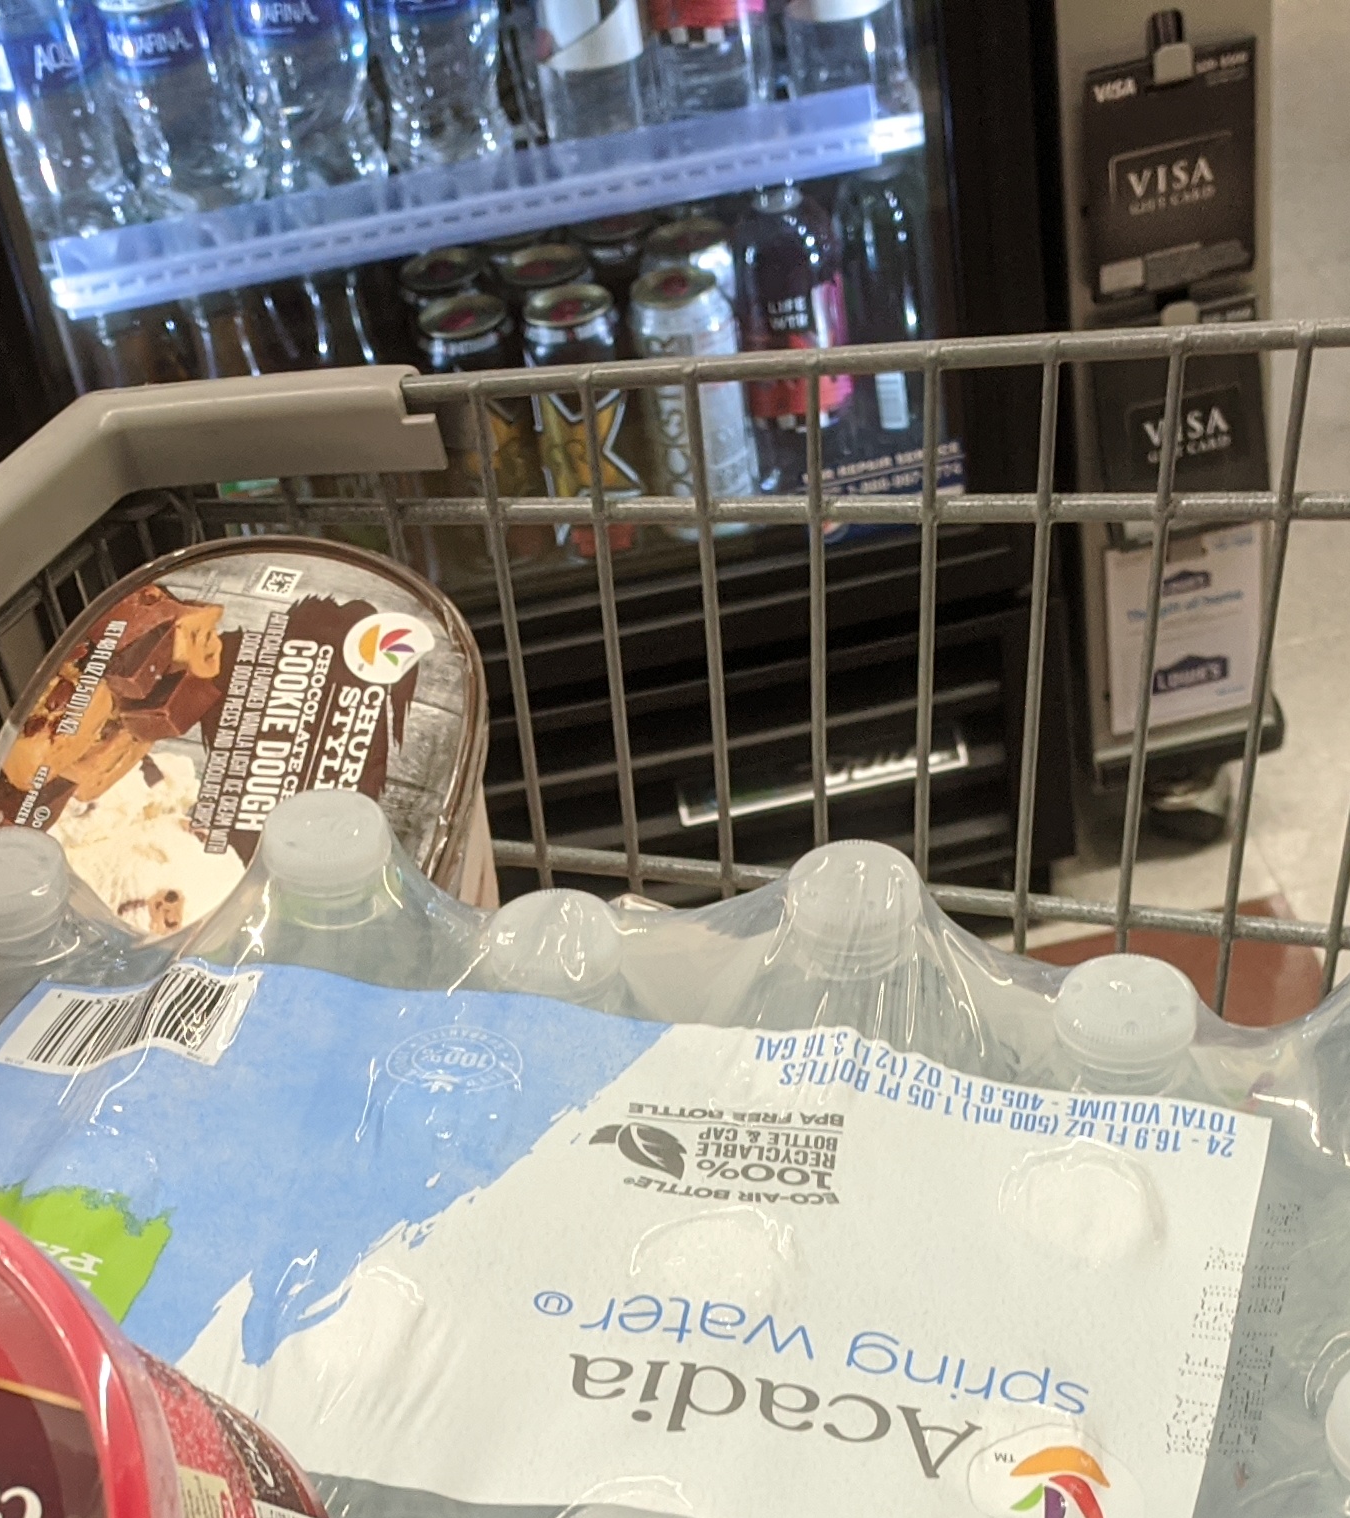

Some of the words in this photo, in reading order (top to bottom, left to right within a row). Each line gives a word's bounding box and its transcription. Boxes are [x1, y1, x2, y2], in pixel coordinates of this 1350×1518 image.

[1091, 75, 1138, 103] VISA
[1126, 155, 1215, 198] VISA
[235, 631, 259, 664] COOKIE
[257, 612, 287, 666] ARTIFICIALLY
[227, 664, 251, 696] DOUGH
[245, 665, 273, 710] FLAVORED
[260, 634, 317, 739] COOKIE
[218, 695, 242, 728] PIECES
[286, 643, 332, 773] CHOCOLATE
[212, 727, 234, 749] AND
[234, 709, 261, 748] VANILLA
[31, 763, 49, 789] KEEP
[199, 749, 228, 801] CHOCOLATE
[226, 749, 249, 777] LIGHT
[235, 737, 287, 835] DOUGH
[14, 787, 39, 826] FROZEN
[191, 801, 215, 830] CHIPS
[213, 794, 238, 827] CREAM
[205, 826, 229, 854] WITH
[751, 1031, 797, 1064] GAL
[874, 1046, 909, 1079] (12
[913, 1059, 942, 1087] OZ
[873, 1072, 902, 1099] PT
[904, 1083, 952, 1115] 1.05
[947, 1074, 973, 1099] FL
[979, 1083, 1044, 1112] 405.6
[628, 1102, 723, 1120] BOTTLE
[799, 1111, 844, 1127] BPA
[961, 1099, 1003, 1125] mL)
[1007, 1107, 1059, 1135] (500
[1065, 1091, 1161, 1127] VOLUME
[1166, 1104, 1238, 1136] TOTAL
[697, 1125, 738, 1142] CAP
[745, 1129, 760, 1144] &
[767, 1131, 838, 1149] BOTTLE
[1064, 1116, 1095, 1139] OZ
[1101, 1121, 1125, 1143] FL
[1133, 1124, 1182, 1153] 16.9
[695, 1140, 835, 1168] RECYCLABLE
[1205, 1133, 1234, 1158] 24
[694, 1158, 833, 1189] 100%
[737, 1185, 839, 1207] ECO-AIR
[579, 1291, 816, 1367] water
[843, 1335, 1091, 1416] spring
[568, 1352, 980, 1479] Acadia
